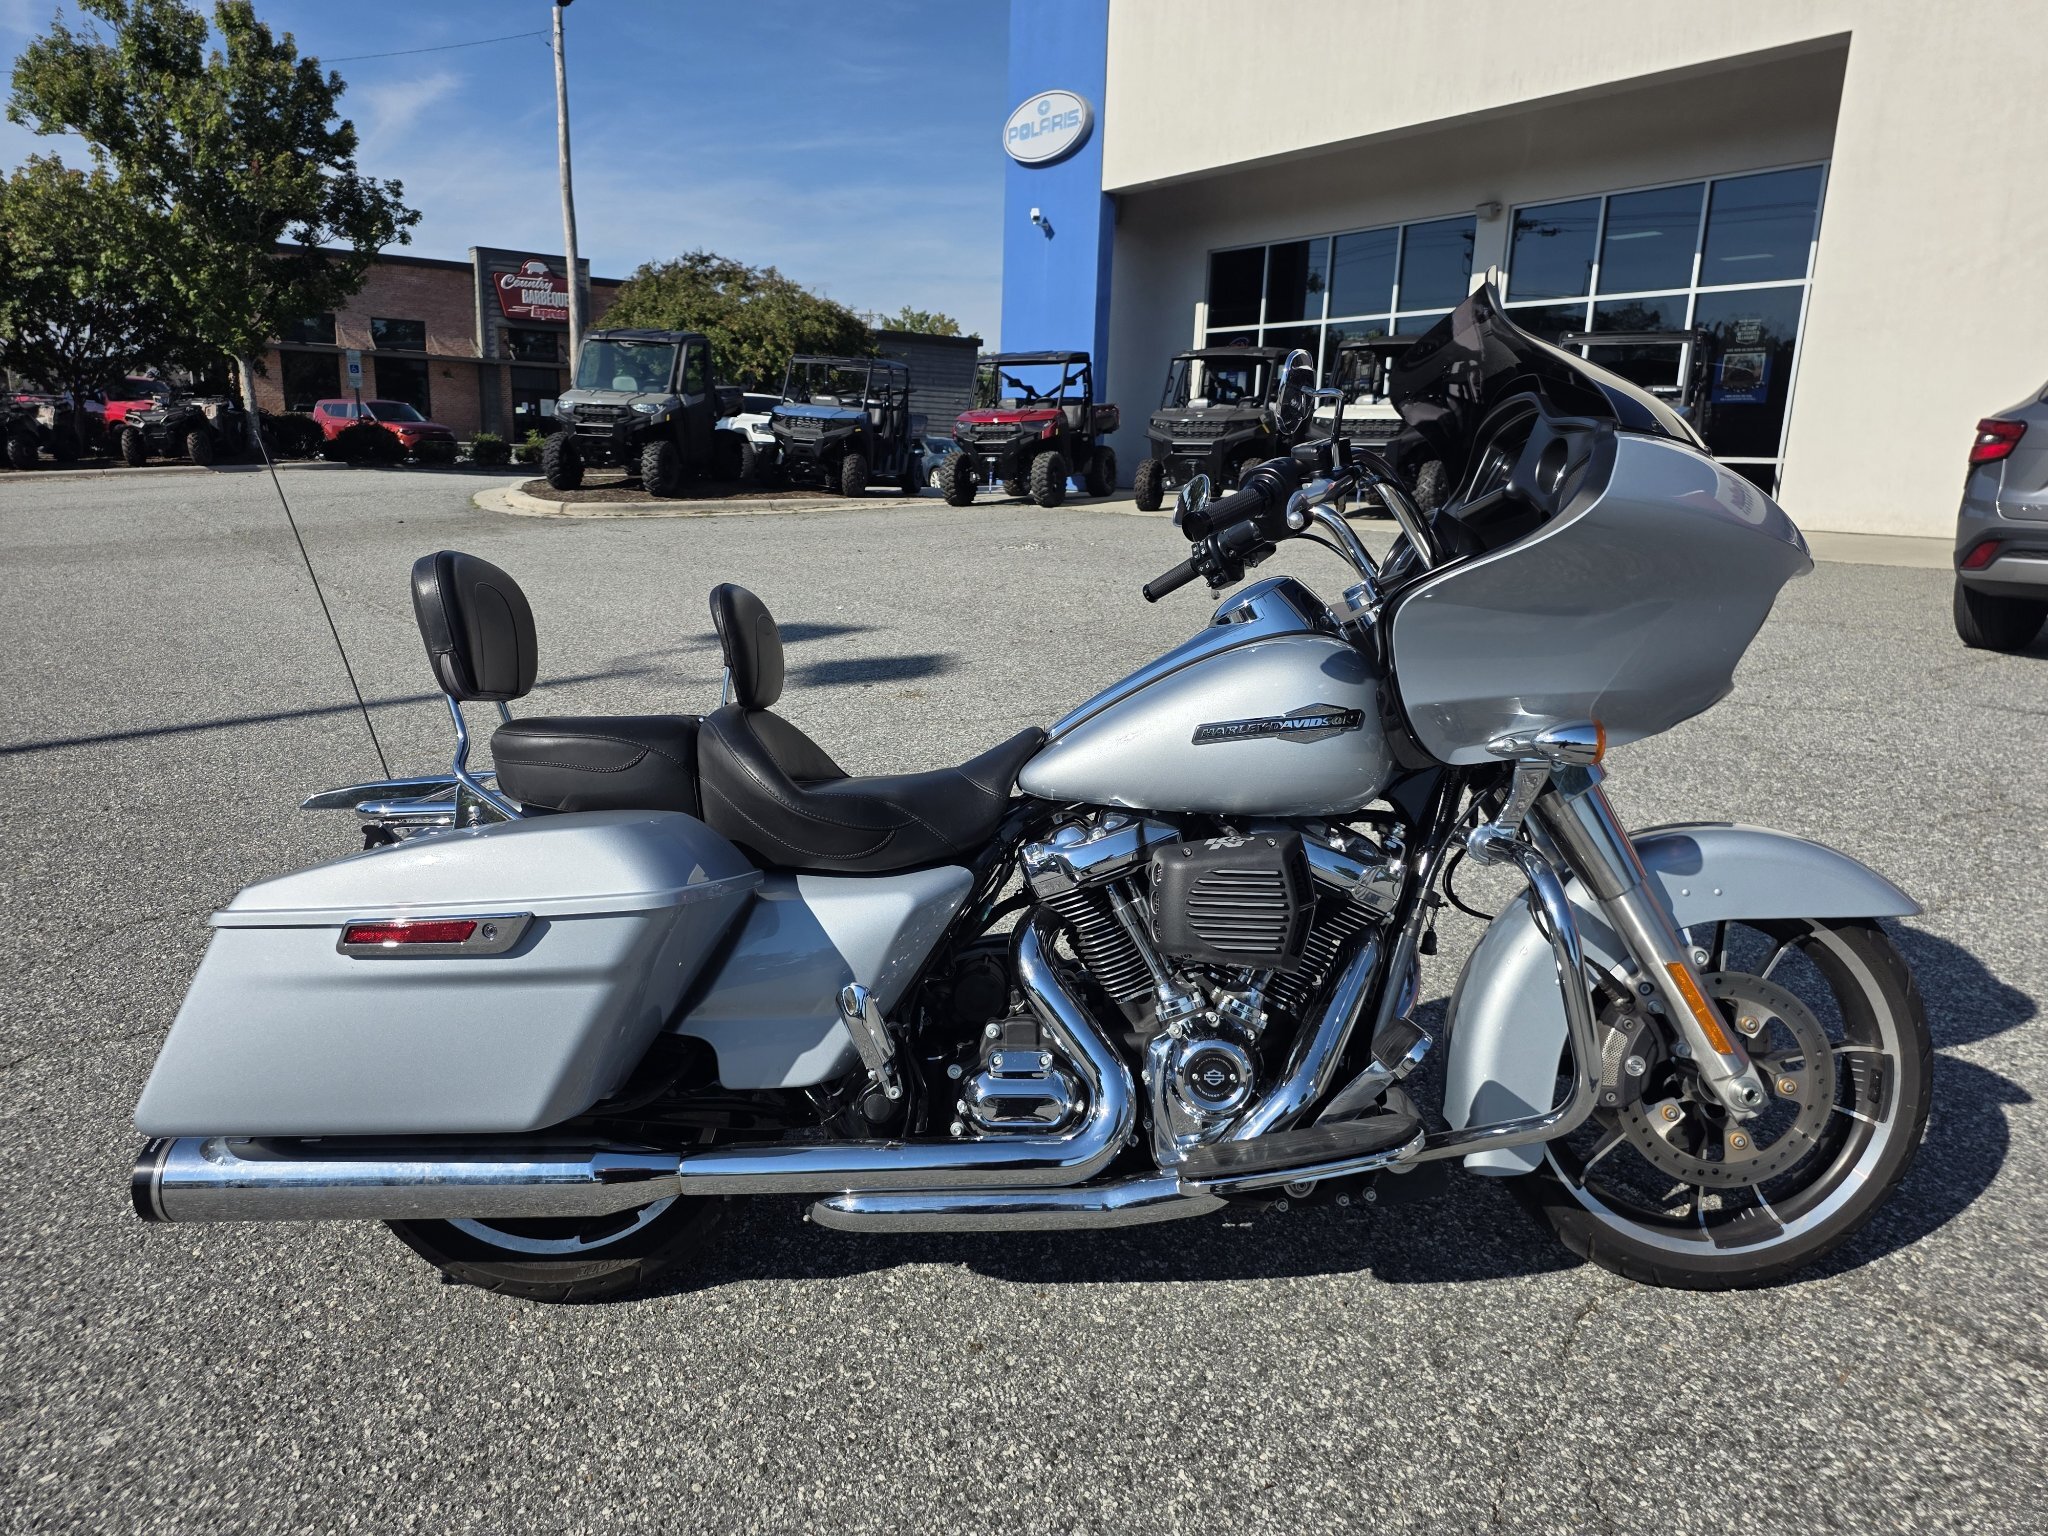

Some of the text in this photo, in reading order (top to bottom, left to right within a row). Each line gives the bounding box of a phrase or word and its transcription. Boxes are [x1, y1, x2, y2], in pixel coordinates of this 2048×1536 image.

[1008, 108, 1080, 144] POLARIS
[501, 274, 553, 293] Country
[522, 289, 569, 308] BARBEQUE
